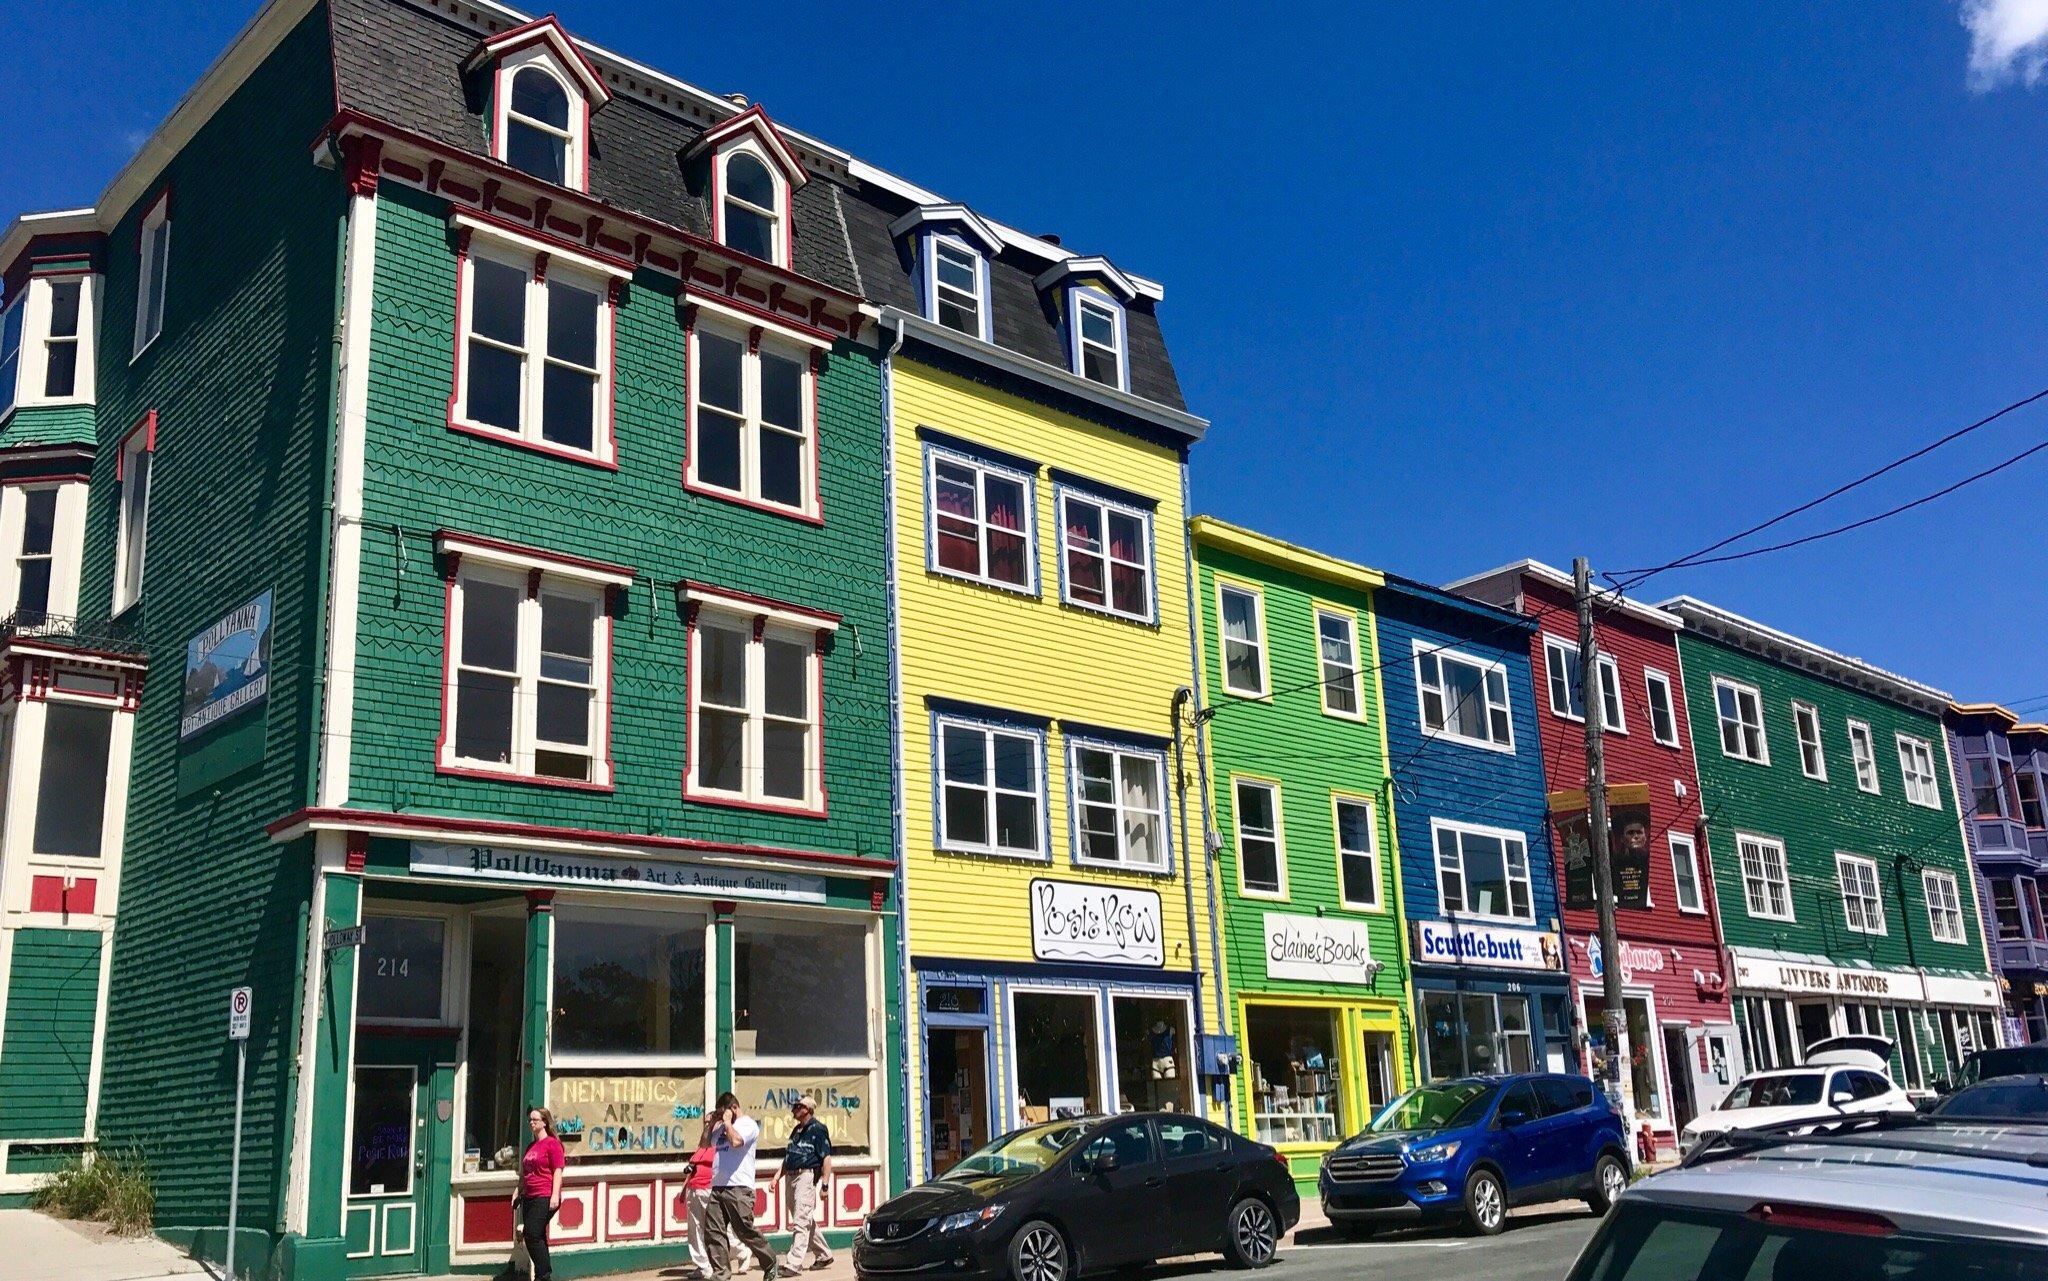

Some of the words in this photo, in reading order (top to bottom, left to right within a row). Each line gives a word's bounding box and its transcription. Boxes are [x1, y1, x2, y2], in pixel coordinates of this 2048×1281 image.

[203, 606, 257, 656] POLLYANNA
[230, 677, 264, 709] GALLERY
[645, 868, 667, 884] Art
[674, 871, 684, 885] &
[693, 873, 738, 890] Antique
[745, 876, 788, 895] Gallery
[1271, 926, 1321, 963] Elaine's
[1322, 930, 1365, 965] Books
[1424, 927, 1523, 960] Scuttlebutt
[377, 957, 408, 977] 214
[1507, 982, 1521, 992] 206
[1779, 967, 1831, 989] LIVYERS
[1837, 972, 1889, 994] ANTIQUES
[563, 1080, 604, 1103] NEW
[610, 1079, 678, 1101] THINGS
[827, 1088, 838, 1109] IS
[604, 1103, 645, 1123] ARE
[588, 1125, 685, 1151] GROWING
